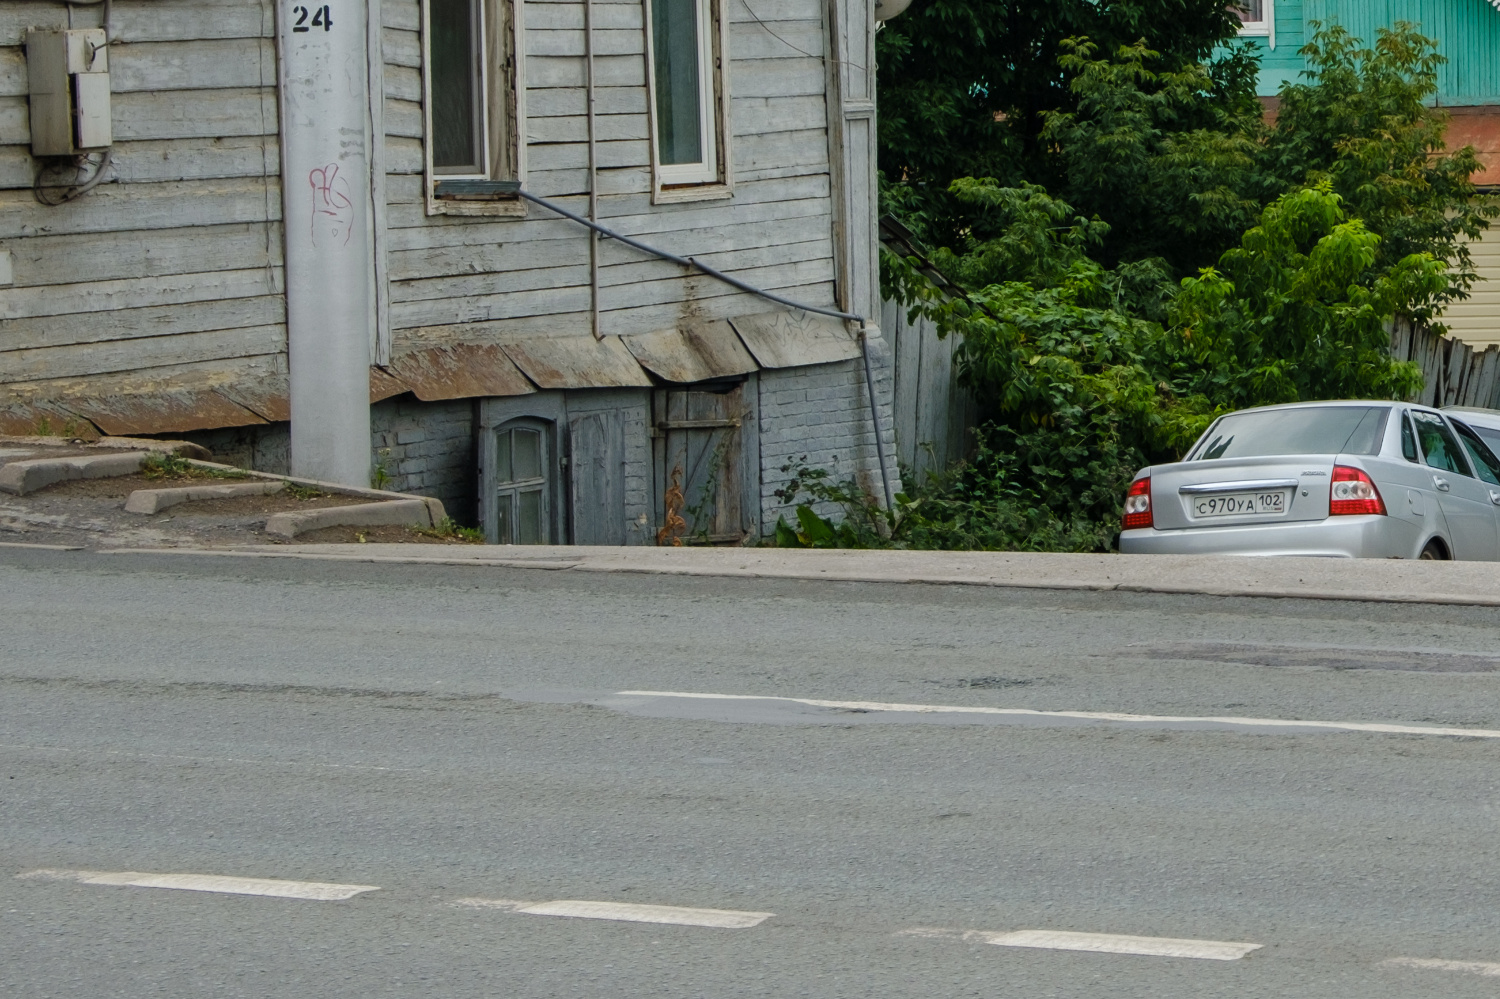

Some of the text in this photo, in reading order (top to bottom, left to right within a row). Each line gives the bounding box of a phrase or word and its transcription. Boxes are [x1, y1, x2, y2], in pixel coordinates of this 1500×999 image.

[293, 5, 333, 32] 24
[1198, 494, 1280, 514] С970УА 102
